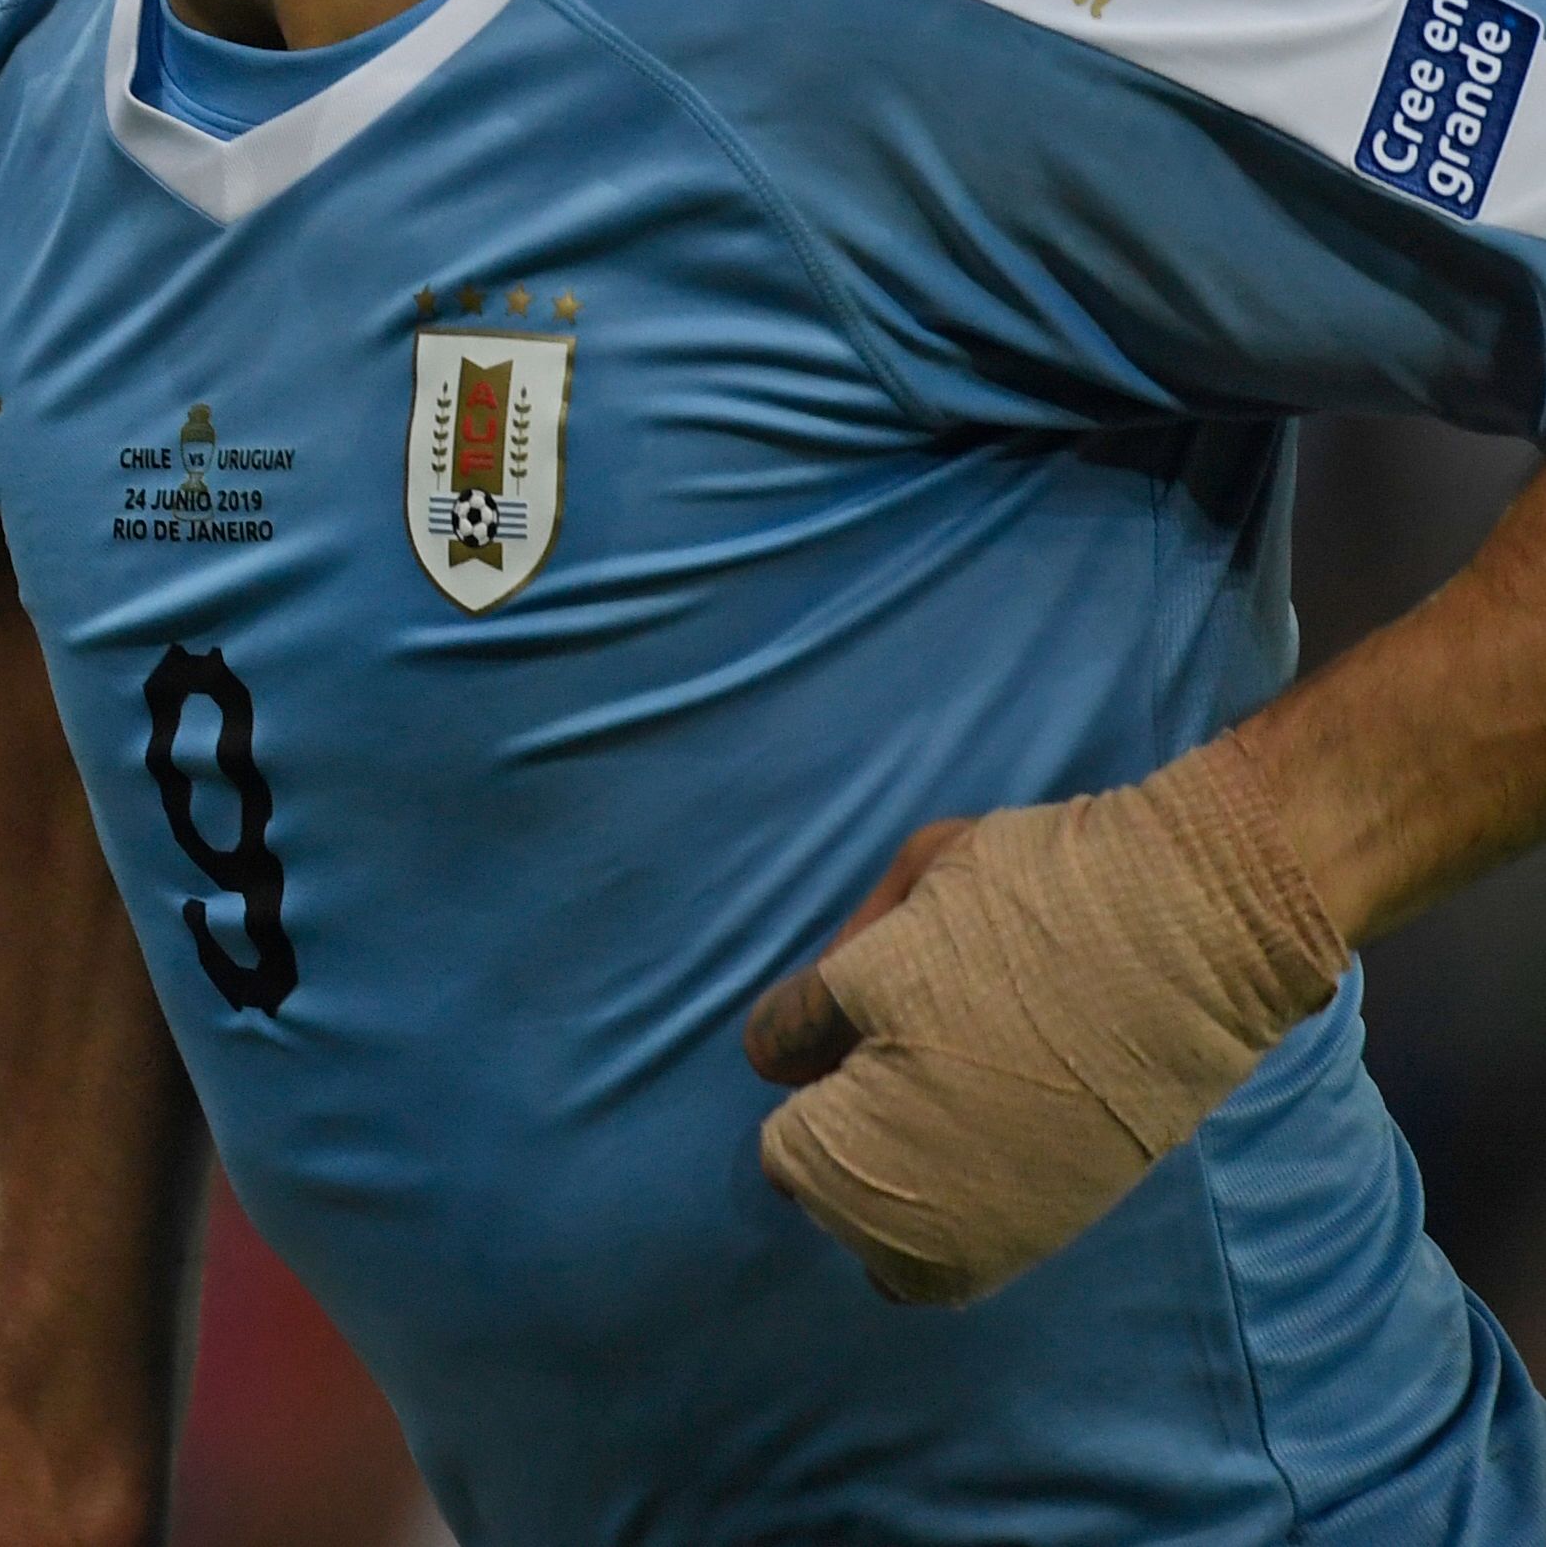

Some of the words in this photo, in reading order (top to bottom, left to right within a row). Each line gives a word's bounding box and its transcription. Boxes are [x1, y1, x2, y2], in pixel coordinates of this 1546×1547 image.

[1372, 58, 1445, 174] Cree
[1428, 21, 1511, 204] grande
[120, 448, 172, 469] CHILE
[217, 448, 296, 471] URUGUAY
[460, 380, 497, 478] AUF
[113, 518, 148, 540] RIO
[154, 519, 181, 542] DE
[186, 520, 274, 543] JANEIRO
[124, 488, 146, 510] 24
[151, 490, 212, 512] JUNIO
[217, 490, 263, 512] 2019
[142, 642, 299, 1019] 9
